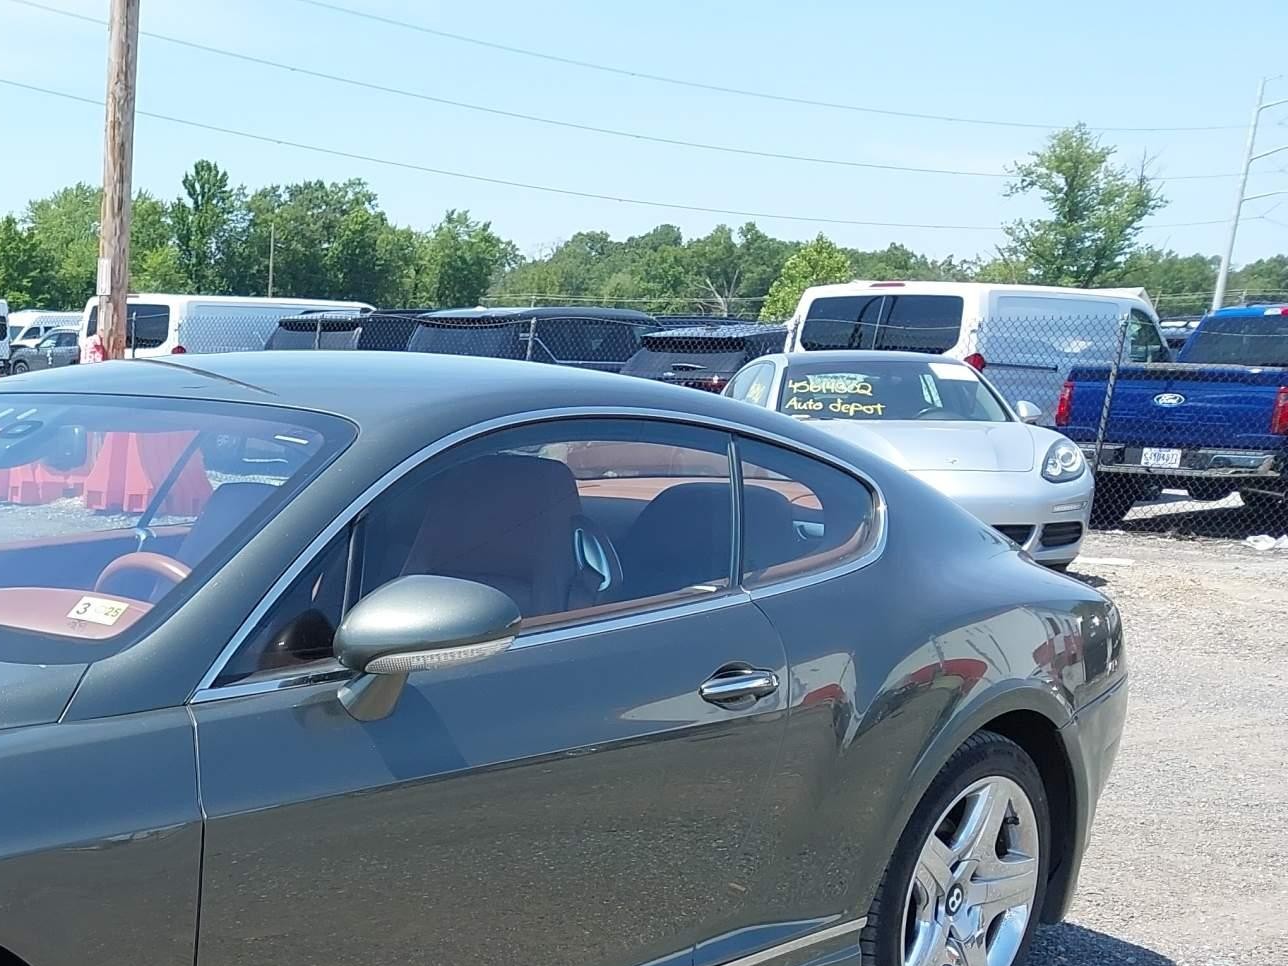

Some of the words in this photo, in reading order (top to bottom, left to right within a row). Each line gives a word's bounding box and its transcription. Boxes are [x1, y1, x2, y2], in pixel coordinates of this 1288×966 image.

[785, 396, 824, 410] Auto
[828, 398, 887, 416] depot
[76, 602, 92, 615] 3
[103, 606, 122, 618] 25
